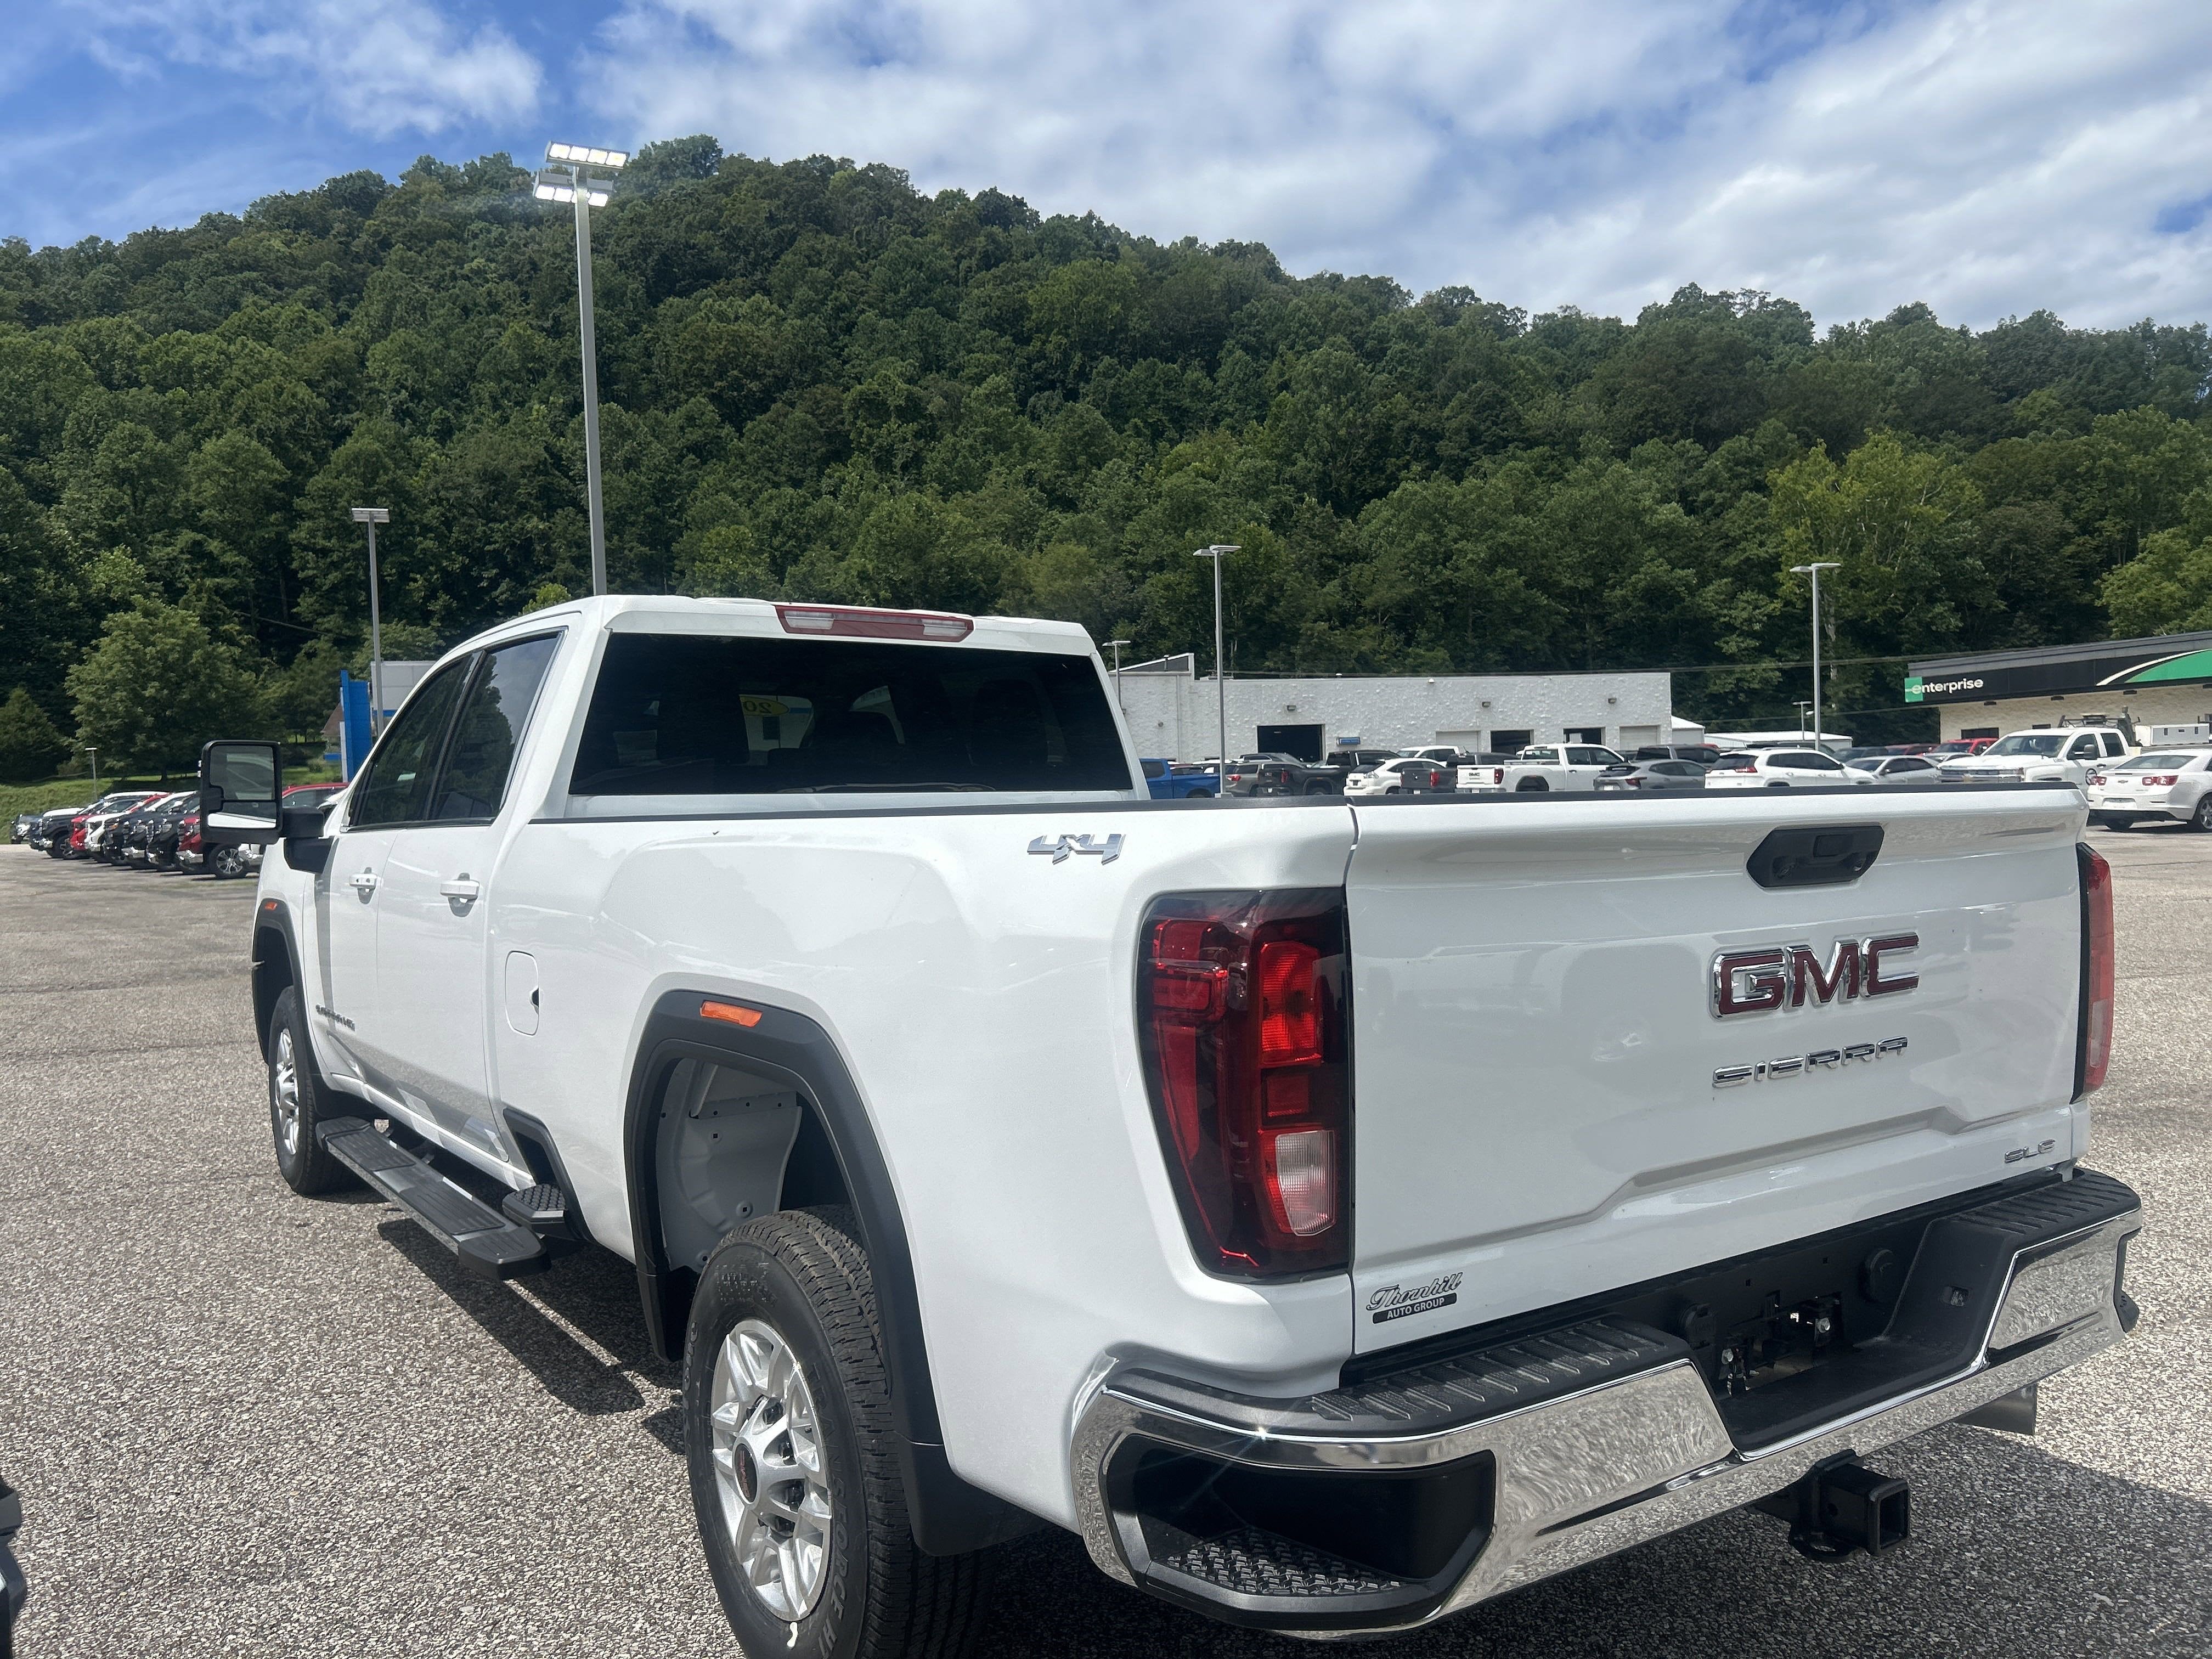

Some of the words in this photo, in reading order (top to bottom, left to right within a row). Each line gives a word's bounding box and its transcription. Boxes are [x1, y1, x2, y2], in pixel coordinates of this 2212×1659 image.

[1911, 678, 1984, 694] enterprise
[1708, 932, 1919, 1020] GMC
[1712, 1036, 1908, 1088] SIERRA
[2005, 1139, 2056, 1163] SLE
[1366, 1272, 1463, 1311] Thornhill
[1387, 1306, 1412, 1320] AUTO
[1414, 1297, 1445, 1313] GROUP
